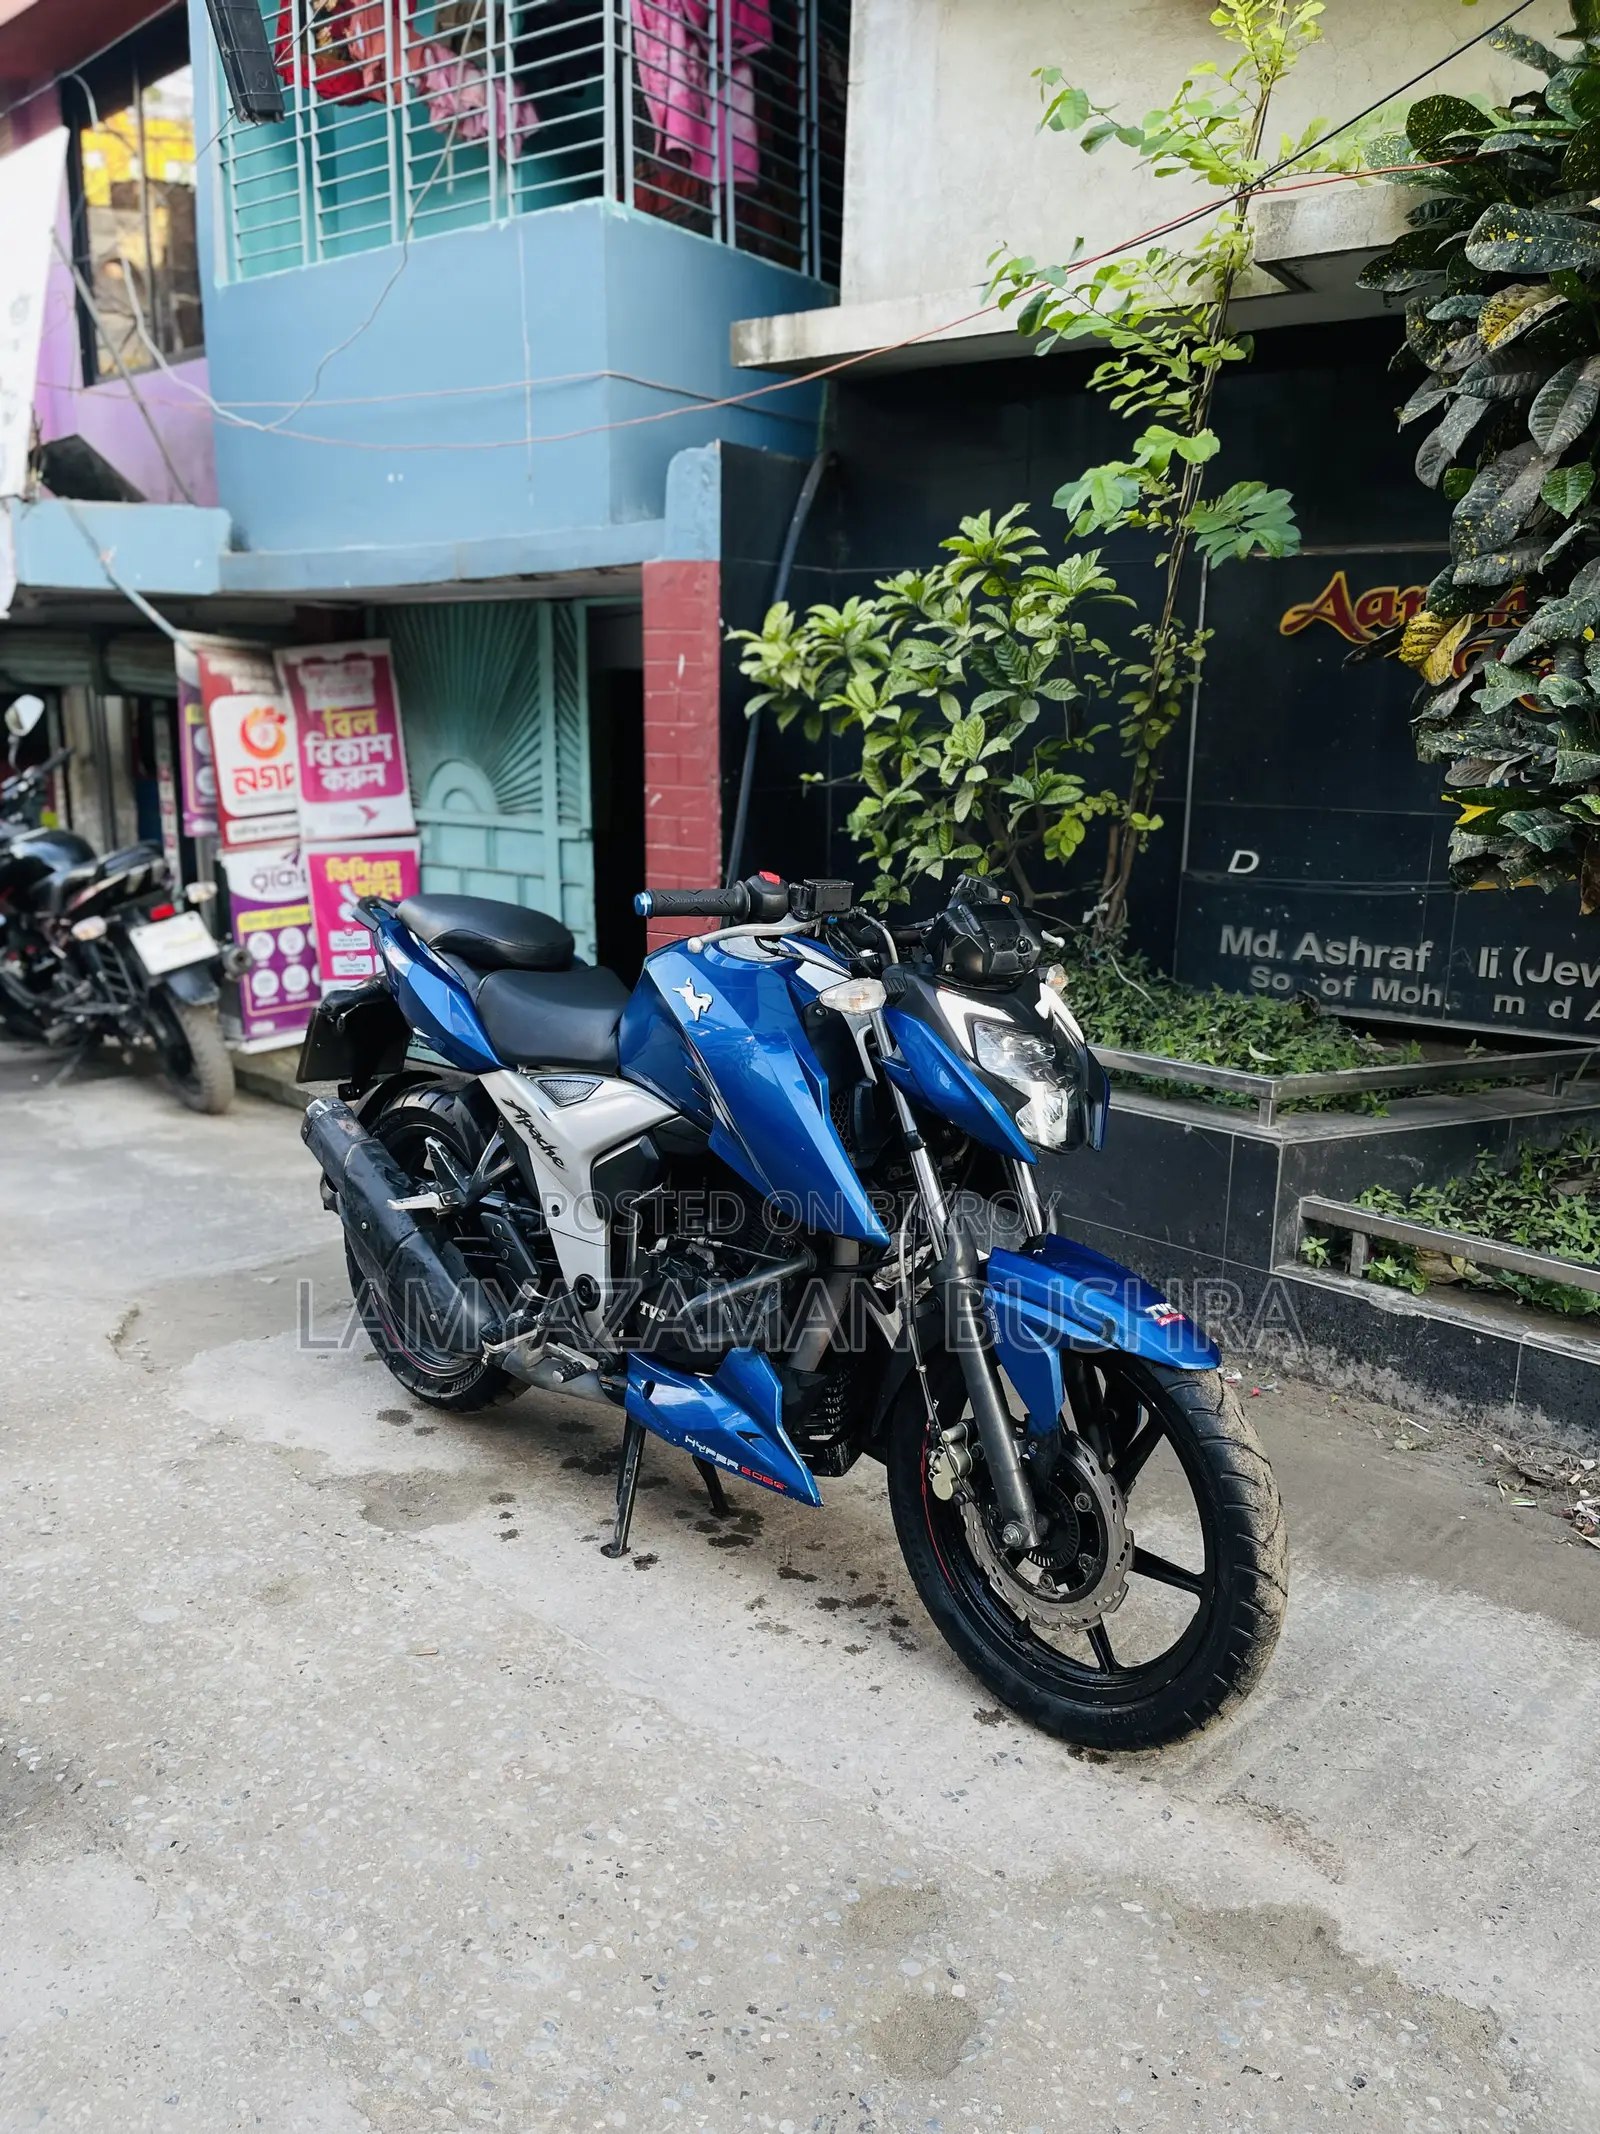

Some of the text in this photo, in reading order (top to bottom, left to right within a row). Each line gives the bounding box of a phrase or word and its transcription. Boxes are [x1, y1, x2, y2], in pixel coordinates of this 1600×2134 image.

[322, 706, 377, 738] বিল
[304, 731, 393, 767] বিকাশ
[1227, 850, 1260, 874] D
[1219, 924, 1283, 960] Md.
[1292, 932, 1435, 973] Ashraf
[1321, 975, 1358, 999] of
[501, 1098, 567, 1171] Apache
[640, 1301, 667, 1323] TVS
[1143, 1302, 1179, 1320] TVS
[684, 1435, 739, 1470] HYPER
